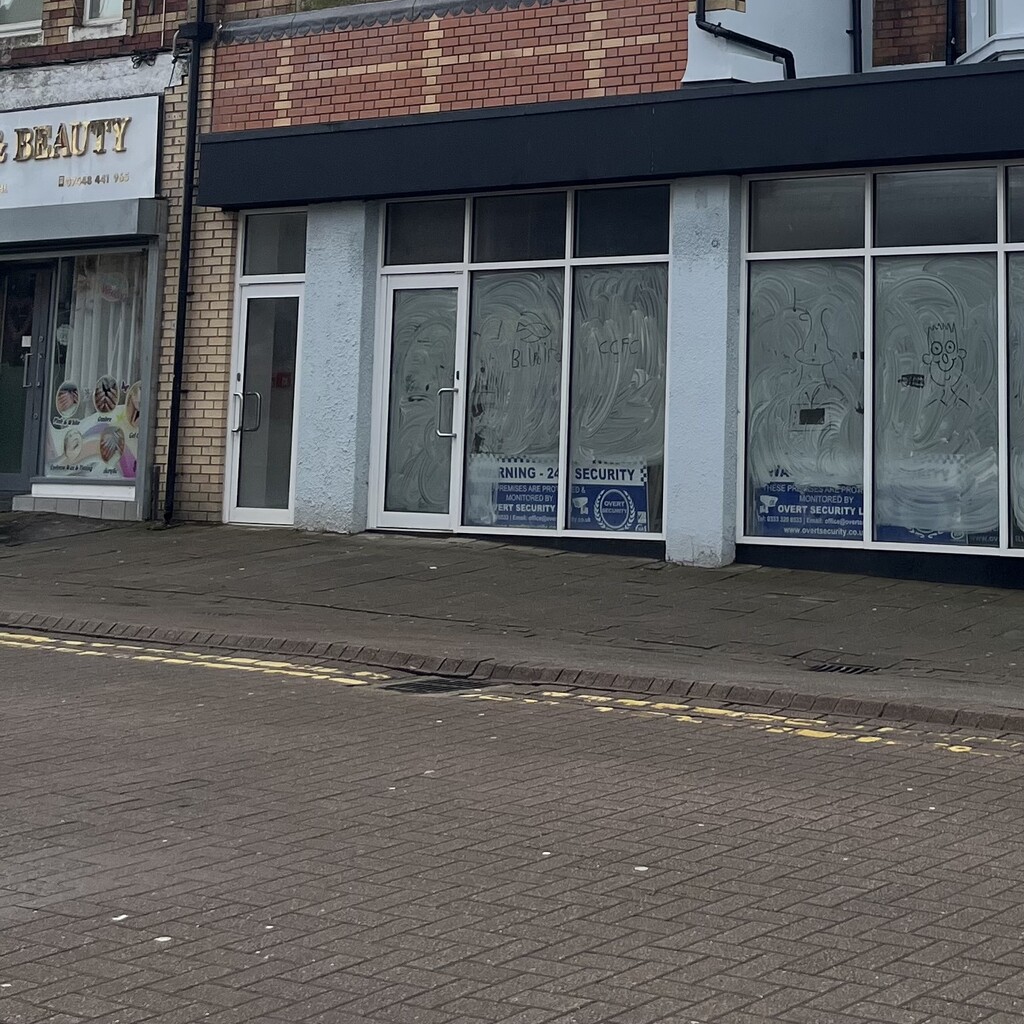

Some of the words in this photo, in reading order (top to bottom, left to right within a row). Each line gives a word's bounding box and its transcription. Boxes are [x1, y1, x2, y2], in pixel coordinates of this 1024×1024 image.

[12, 116, 132, 162] BEAUTY
[499, 467, 536, 479] RNING
[575, 467, 635, 481] SECURITY
[528, 485, 542, 493] ARE
[506, 494, 544, 502] MONITORED
[544, 494, 554, 502] BY
[799, 495, 842, 503] MONITORED
[843, 495, 854, 504] BY
[495, 504, 514, 512] VERT
[516, 504, 556, 513] SECURITY
[777, 505, 807, 514] OVERT
[810, 505, 856, 515] SECURITY
[783, 526, 864, 537] www.overtsecurity.co.u
